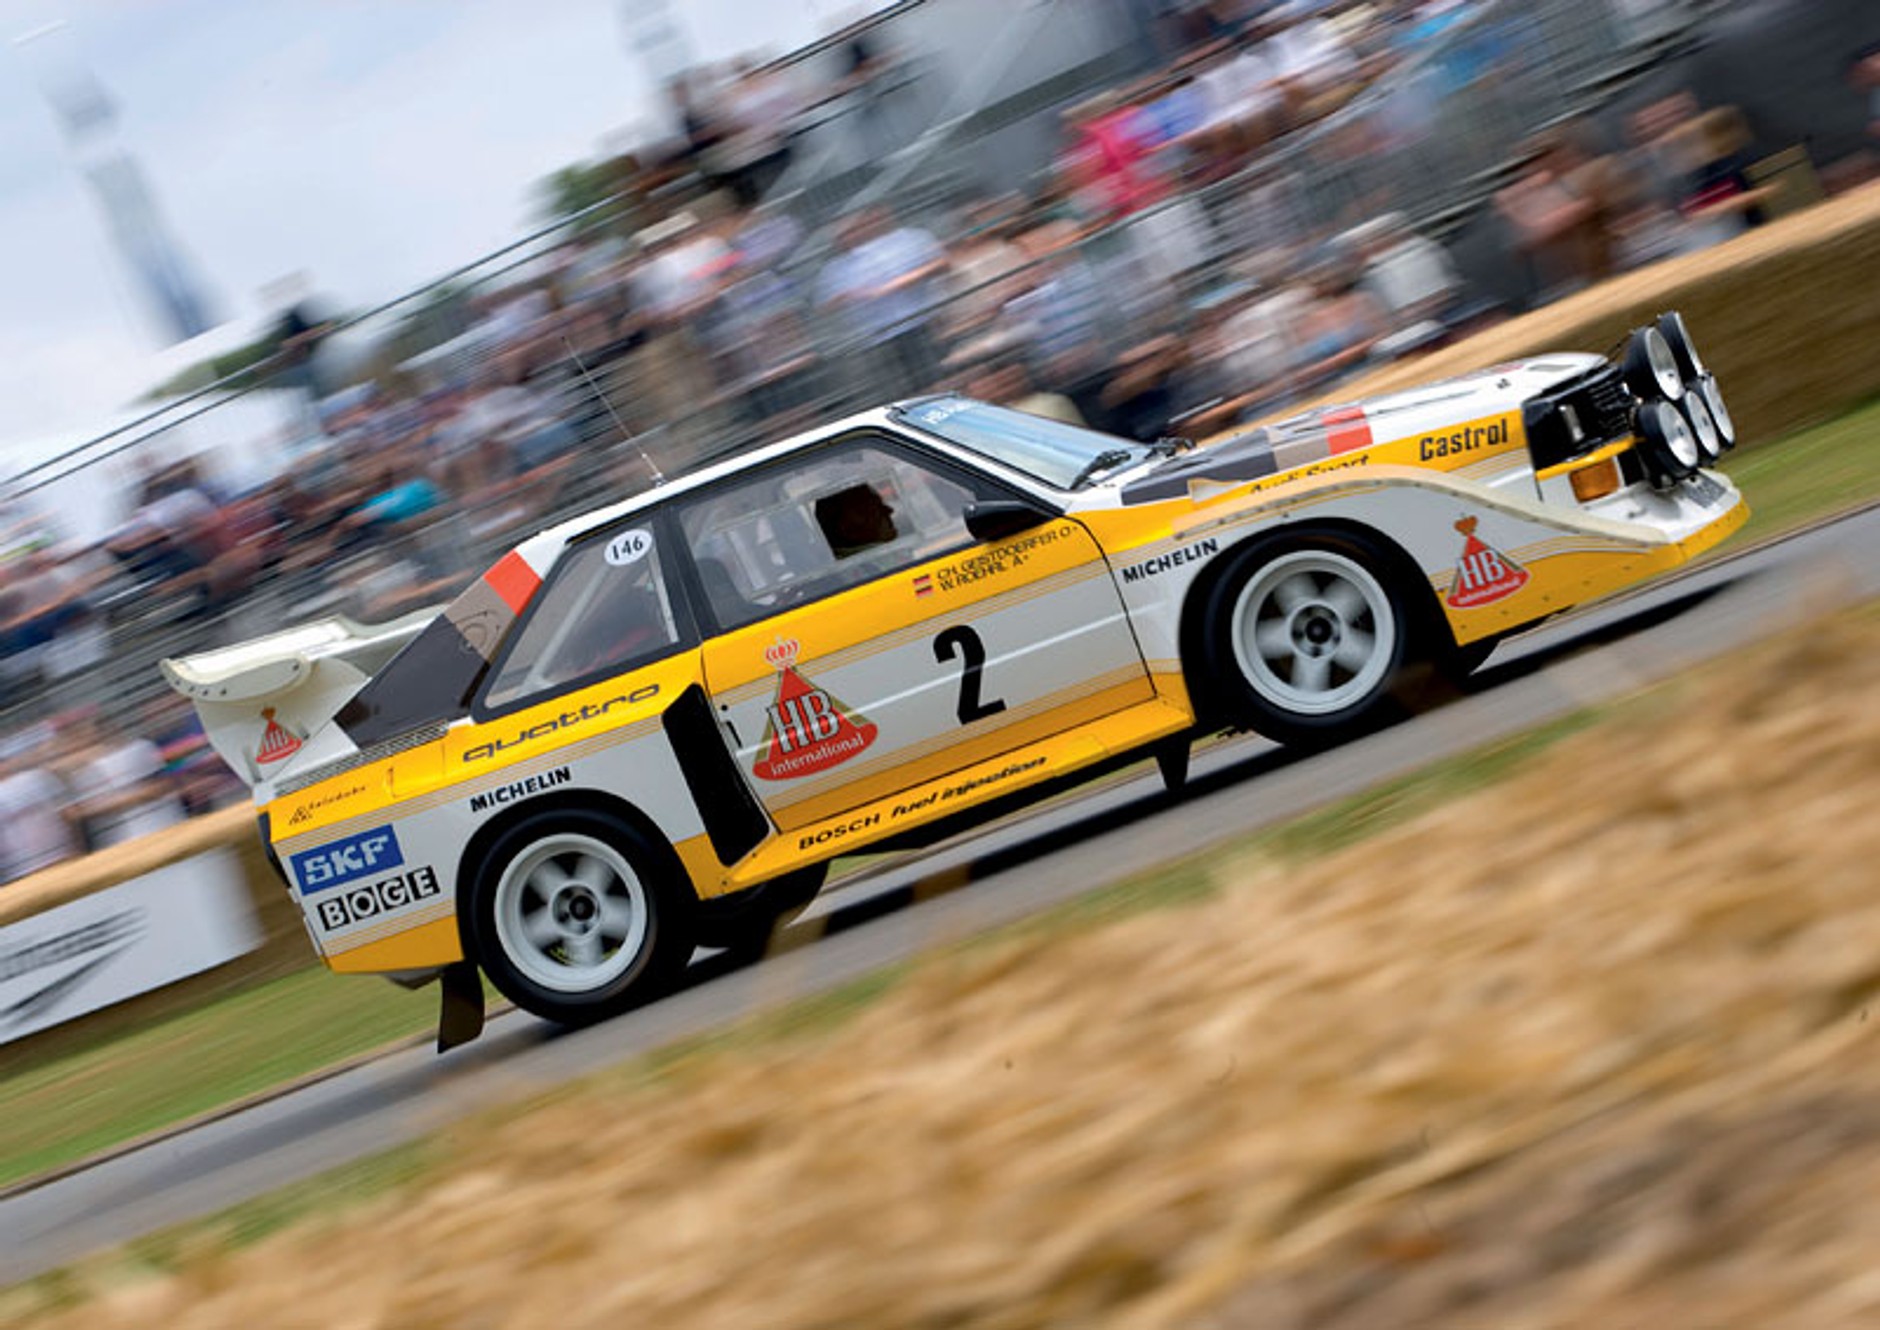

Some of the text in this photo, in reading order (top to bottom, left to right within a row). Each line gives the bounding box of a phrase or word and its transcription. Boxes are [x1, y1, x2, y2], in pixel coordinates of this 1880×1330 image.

[1419, 417, 1508, 462] Castrol
[612, 535, 644, 560] 146
[1121, 537, 1219, 585] MICHELIN
[1456, 548, 1506, 590] HB
[933, 624, 1007, 725] 2
[463, 684, 660, 763] quattro
[765, 688, 840, 755] HB
[770, 732, 865, 777] international
[469, 766, 572, 813] MICHELIN
[798, 812, 881, 850] BOSCH
[890, 791, 938, 819] fuel
[303, 834, 390, 886] SKF
[320, 867, 437, 929] BOGE
